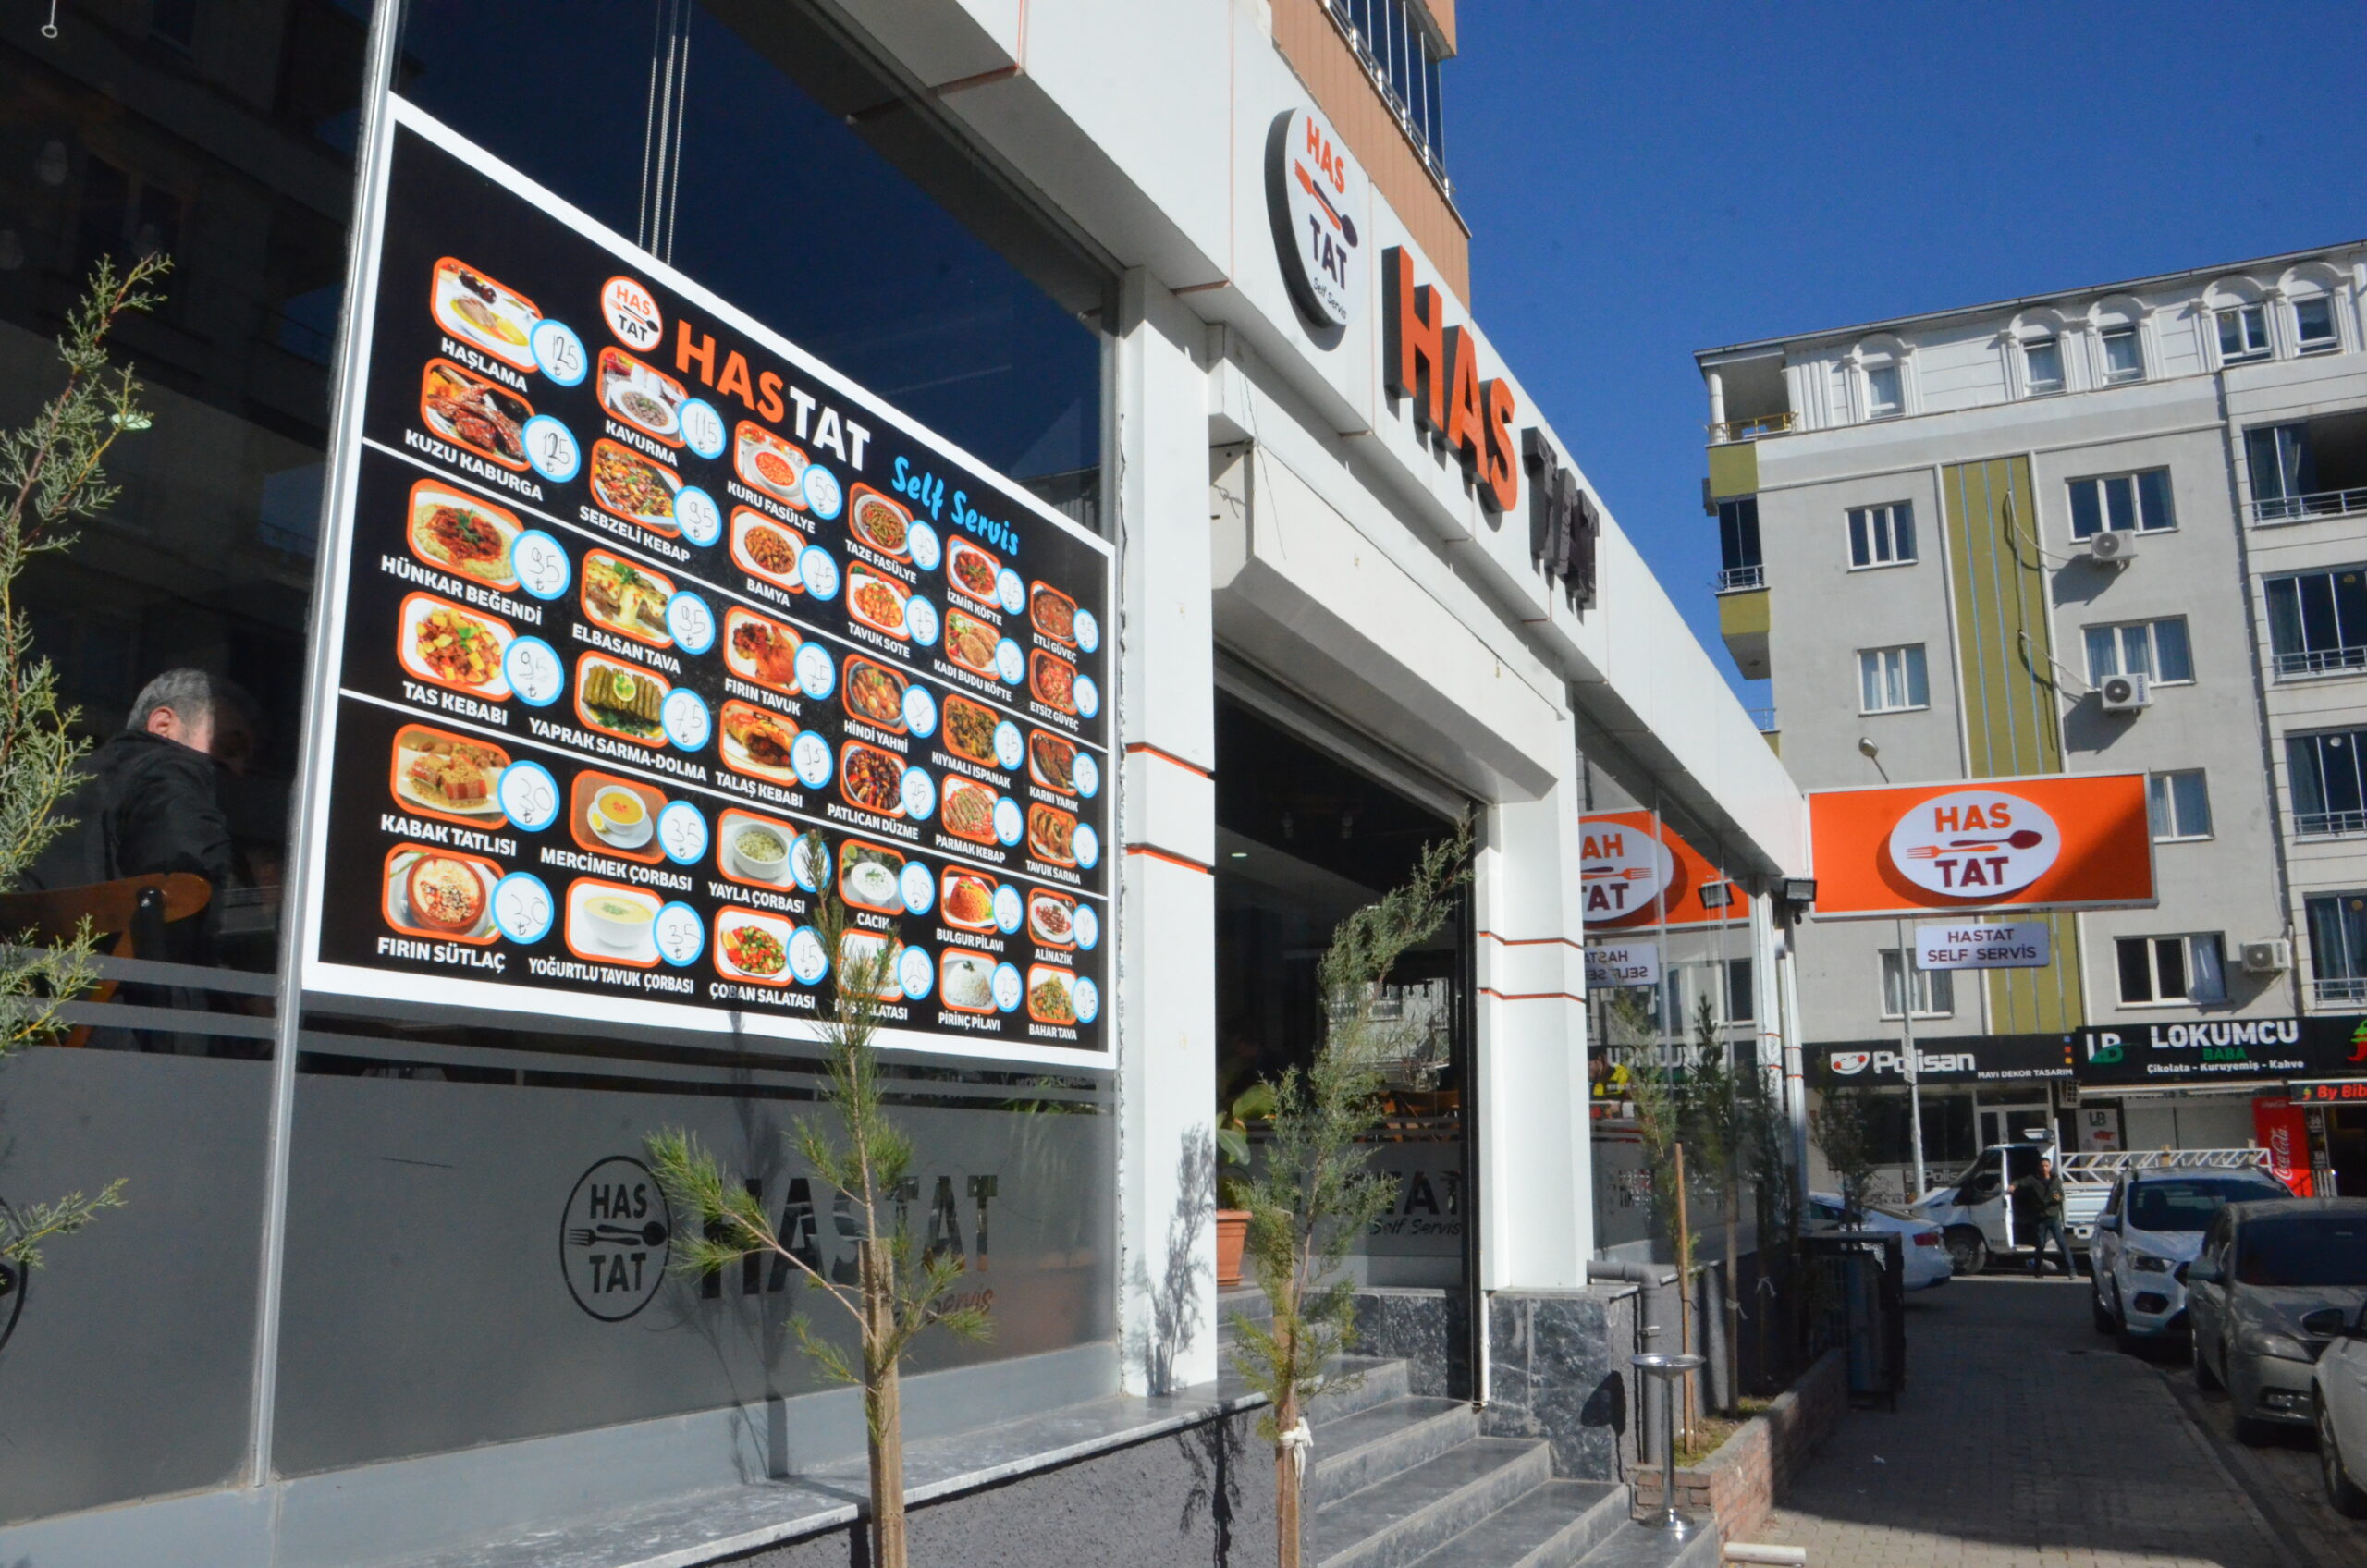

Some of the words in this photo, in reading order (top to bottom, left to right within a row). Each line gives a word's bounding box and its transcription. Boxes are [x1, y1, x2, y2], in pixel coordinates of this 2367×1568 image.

[1306, 116, 1344, 194] HAS
[1309, 214, 1348, 290] TAT
[616, 285, 652, 316] HAS
[618, 314, 649, 343] TAT
[441, 337, 528, 393] HAŞLAMA
[551, 336, 579, 372] 125
[605, 419, 679, 467] KAVURMA
[694, 411, 717, 444] 115
[404, 428, 458, 463] KUZU
[459, 452, 544, 502] KABURGA
[543, 432, 570, 466] 125
[815, 476, 838, 503] 50
[891, 456, 944, 521] Self
[950, 490, 1019, 556] Servis
[727, 481, 763, 508] KURU
[764, 499, 816, 534] FASÜLYE
[579, 505, 642, 543] SEBZELİ
[643, 530, 692, 563] KEBAP
[844, 539, 872, 563] TAZE
[873, 548, 917, 585] FASÜLYE
[381, 554, 463, 599] HÜNKAR
[466, 585, 542, 626] BEĞENDİ
[746, 578, 791, 607] BAMYA
[947, 587, 974, 612] İZMİR
[974, 602, 1002, 627] KÖFTE
[571, 623, 643, 662] ELBASAN
[644, 648, 681, 674] TAVA
[848, 621, 884, 648] TAVUK
[884, 636, 911, 658] SOTE
[1033, 632, 1052, 649] ETLİ
[1051, 642, 1077, 665] GÜVEÇ
[724, 677, 759, 702] FIRIN
[760, 690, 801, 717] TAVUK
[933, 658, 957, 679] KADI
[957, 667, 984, 690] BUDU
[984, 677, 1012, 703] KÖFTE
[402, 680, 438, 706] TAS
[440, 692, 509, 726] KEBABI
[1029, 700, 1053, 719] ETSİZ
[1052, 711, 1079, 732] GÜVEÇ
[528, 717, 596, 750] YAPRAK
[596, 737, 707, 782] SARMA-DOLMA
[843, 718, 875, 741] HİNDİ
[876, 730, 909, 753] YAHNİ
[931, 751, 972, 777] KIYMALI
[972, 766, 1011, 789] ISPANAK
[715, 771, 757, 798] TALAŞ
[758, 783, 803, 808] KEBABI
[1029, 785, 1055, 803] KARNI
[1055, 796, 1079, 813] YARIK
[828, 803, 880, 830] PATLICAN
[881, 819, 919, 841] DÜZME
[1934, 802, 2012, 833] HAS
[381, 814, 448, 844] KABAK
[450, 828, 518, 857] TATLISI
[935, 834, 975, 856] PARMAK
[975, 843, 1006, 864] KEBAP
[540, 847, 628, 879] MERCİMEK
[628, 864, 693, 892] ÇORBASI
[1025, 859, 1053, 877] TAVUK
[1052, 867, 1081, 886] SARMA
[1934, 856, 2009, 888] TAT
[707, 881, 751, 904] YAYLA
[751, 890, 806, 915] ÇORBASI
[856, 912, 889, 931] CACIK
[1947, 927, 2016, 944] HASTAT
[376, 936, 432, 962] FIRIN
[433, 942, 507, 975] SÜTLAÇ
[936, 928, 975, 947] BULGUR
[975, 933, 1004, 953] PİLAVI
[1034, 947, 1073, 966] ALİNAZİK
[1928, 949, 1968, 962] SELF
[1976, 942, 2037, 962] SERVİS
[528, 955, 599, 983] YOĞURTLU
[599, 966, 641, 988] TAVUK
[643, 973, 694, 995] ÇORBASI
[708, 981, 756, 1004] ÇOBAN
[756, 990, 816, 1010] SALATASI
[938, 1010, 971, 1031] PİRİNÇ
[971, 1013, 1001, 1032] PİLAVI
[1028, 1023, 1058, 1038] BAHAR
[1057, 1026, 1078, 1041] TAVA
[2150, 1020, 2300, 1048] LOKUMCU
[2147, 1062, 2190, 1074] Çikolata
[2200, 1061, 2259, 1073] Kuruyemiş
[2269, 1059, 2304, 1070] Kahve
[2202, 1047, 2248, 1060] BABA
[2000, 1070, 2032, 1078] DEKOR
[2033, 1068, 2073, 1077] TASARIM
[2317, 1084, 2337, 1101] By
[590, 1183, 647, 1219] HAS
[1411, 1218, 1463, 1236] Servis
[589, 1252, 646, 1293] TAT
